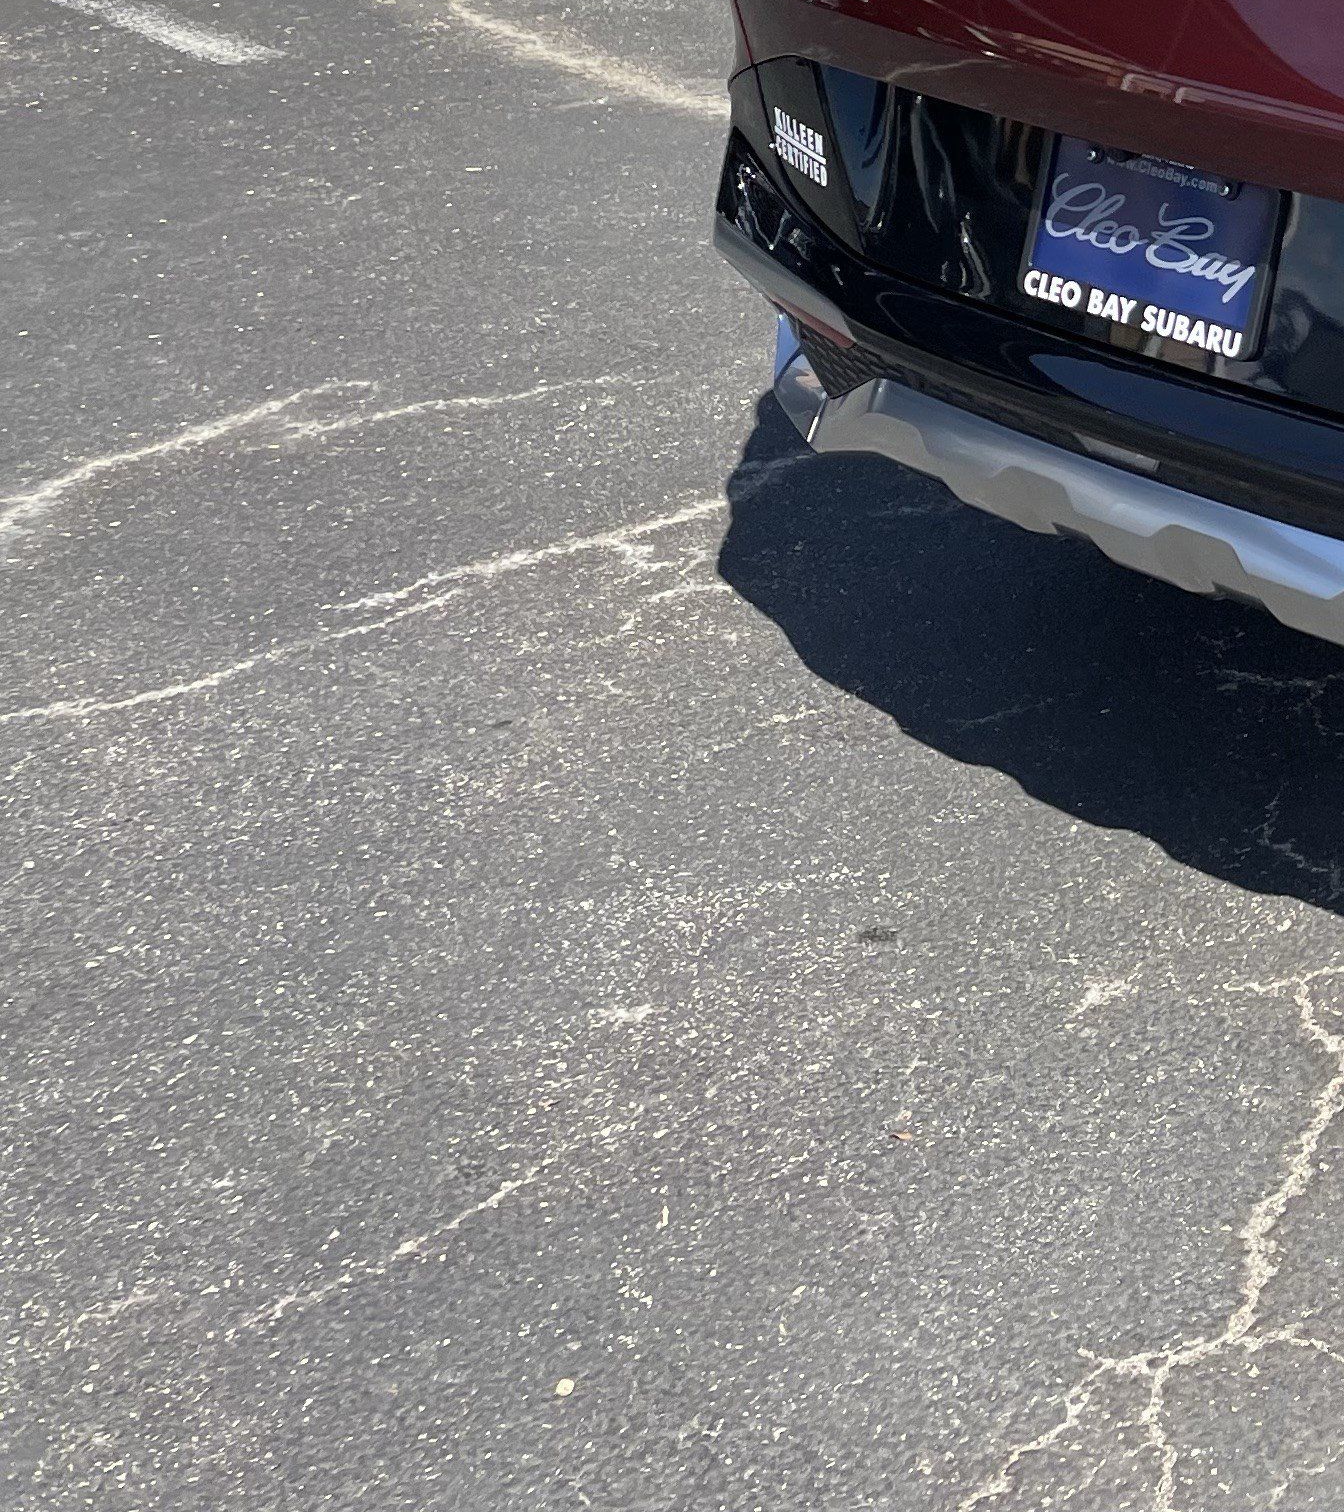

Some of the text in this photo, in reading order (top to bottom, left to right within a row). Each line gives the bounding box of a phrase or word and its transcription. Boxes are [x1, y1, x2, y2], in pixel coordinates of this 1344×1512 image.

[774, 106, 824, 156] KILLEEN
[775, 134, 828, 187] CERTIFIED
[1045, 173, 1256, 303] Cleo Bay
[1023, 270, 1243, 358] CLEO BAY SUBARU
